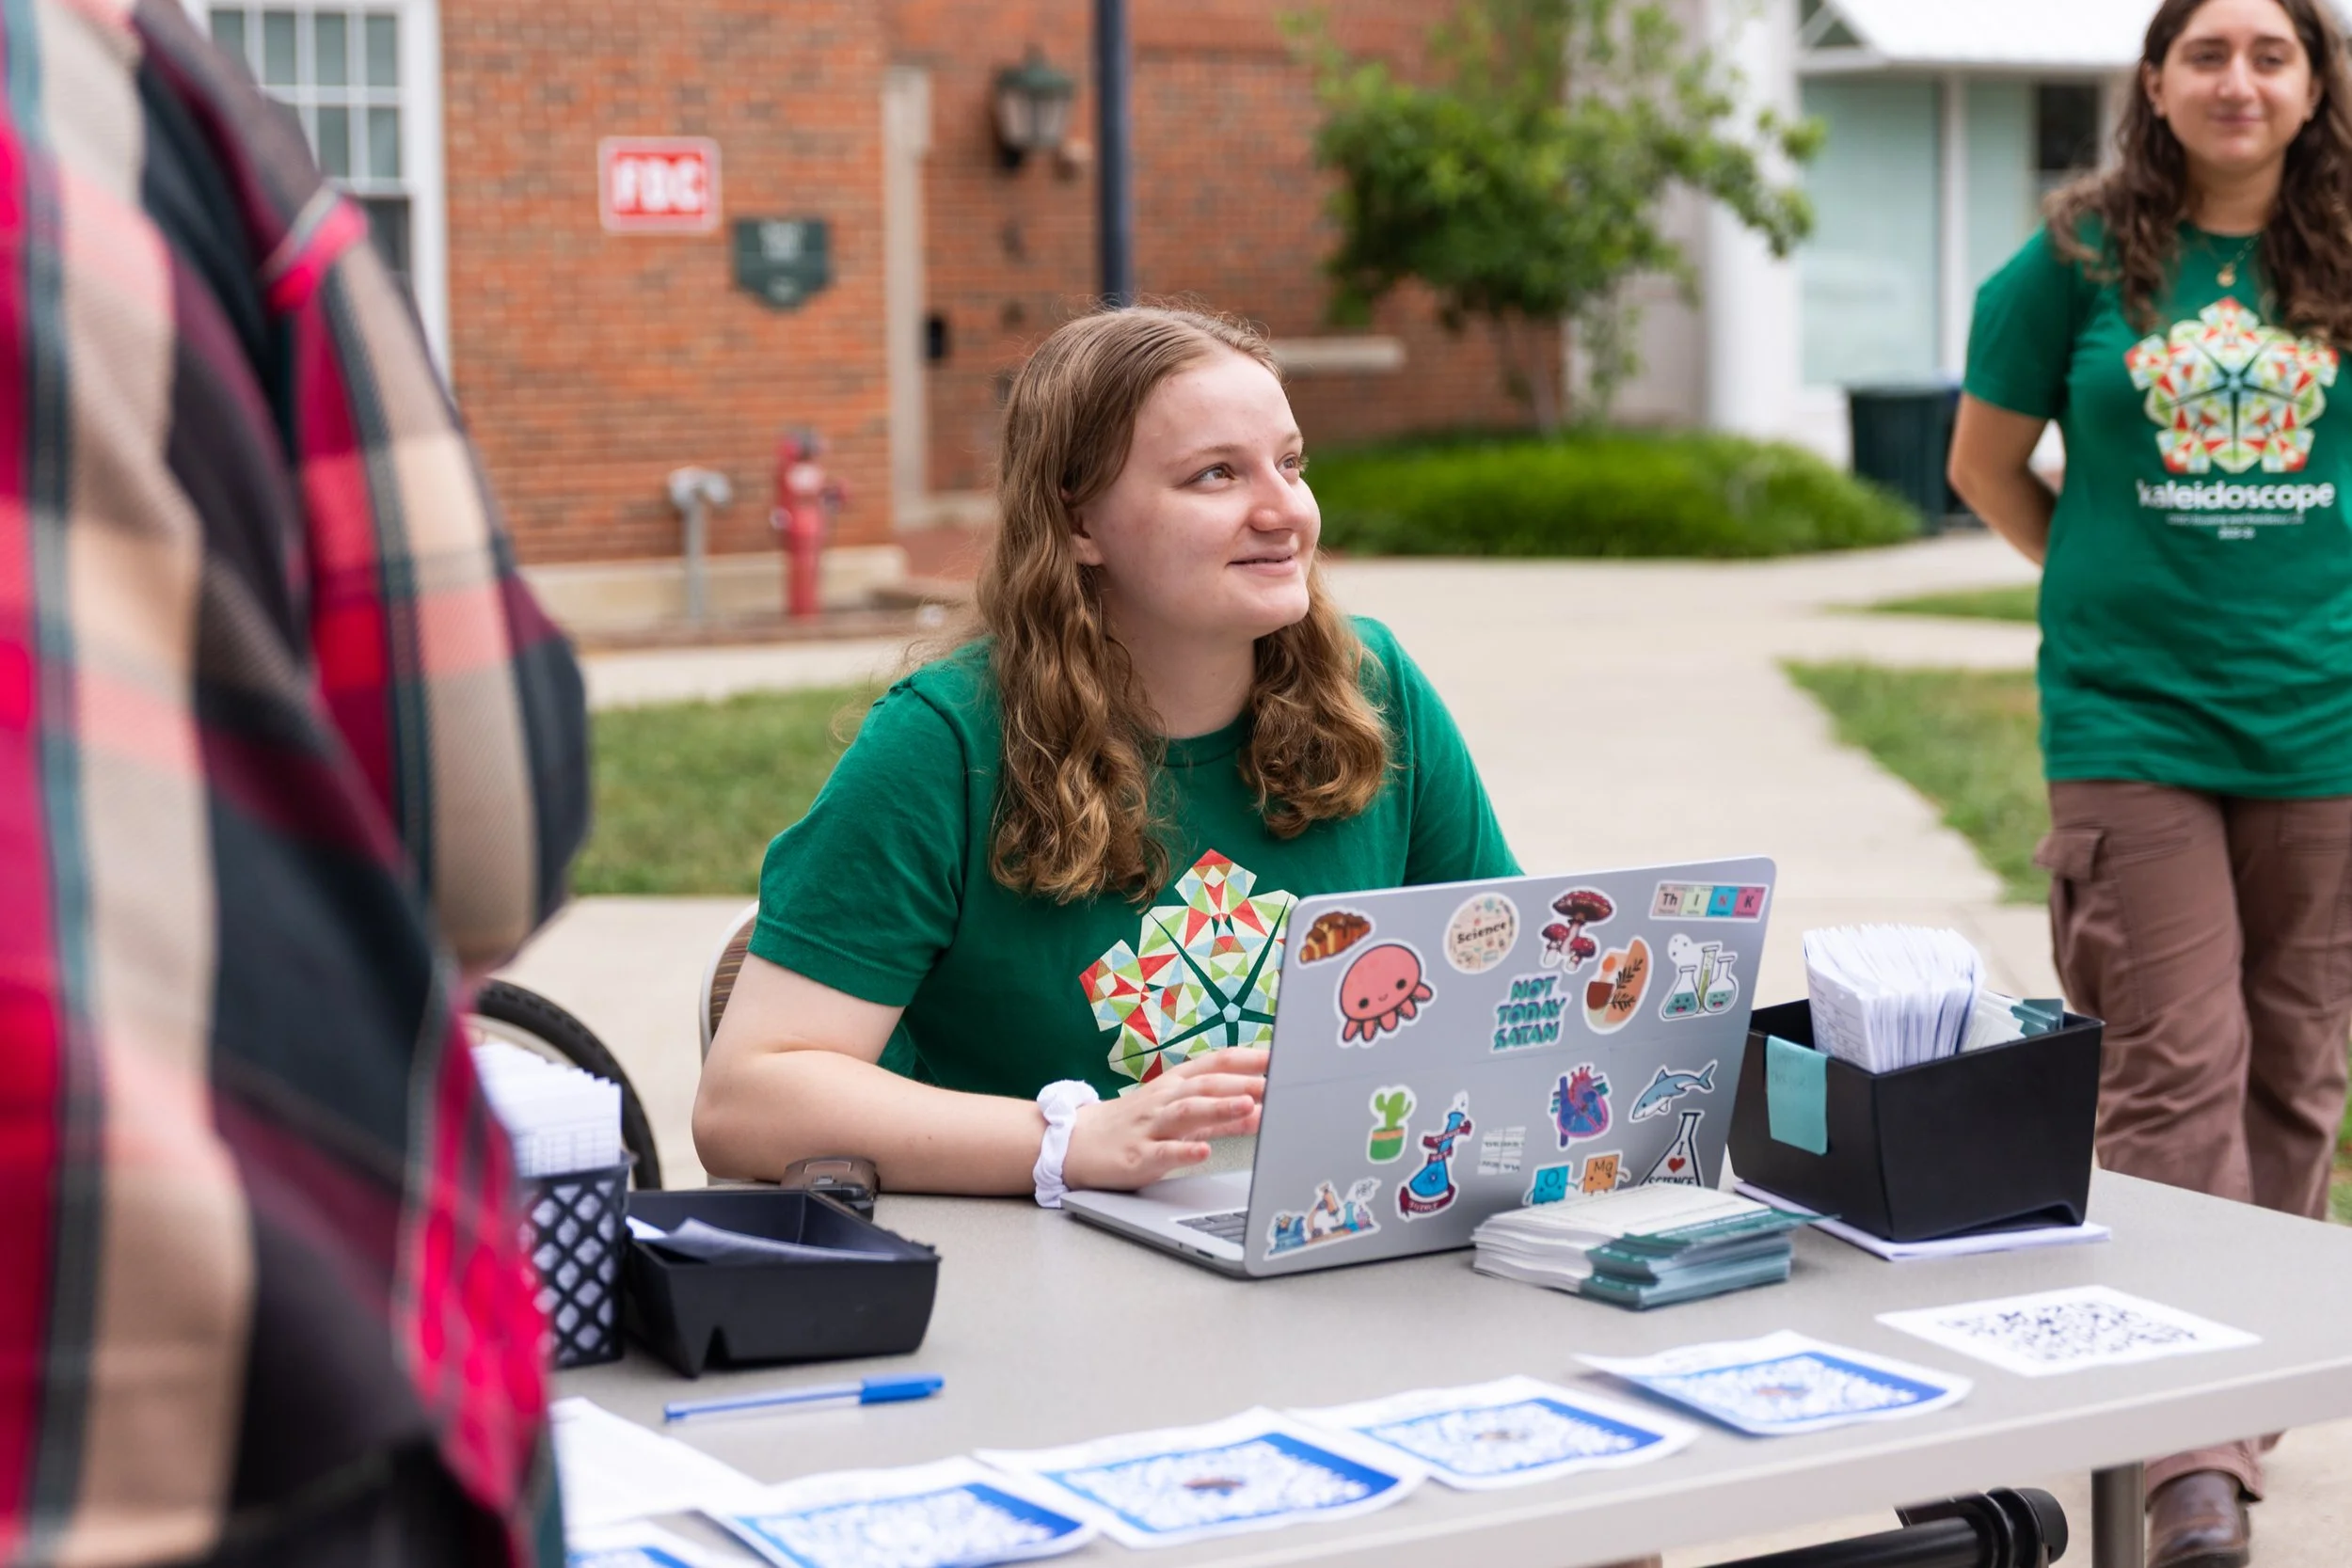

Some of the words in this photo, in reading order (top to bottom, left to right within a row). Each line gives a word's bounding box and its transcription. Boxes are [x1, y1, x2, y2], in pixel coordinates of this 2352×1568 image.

[2136, 478, 2335, 514] kaleidoscope
[1743, 895, 1755, 908] K
[1510, 975, 1558, 1002] NOT
[1497, 997, 1567, 1026] TODAY
[1493, 1021, 1561, 1050] SATAN
[1594, 1160, 1613, 1178] Mg
